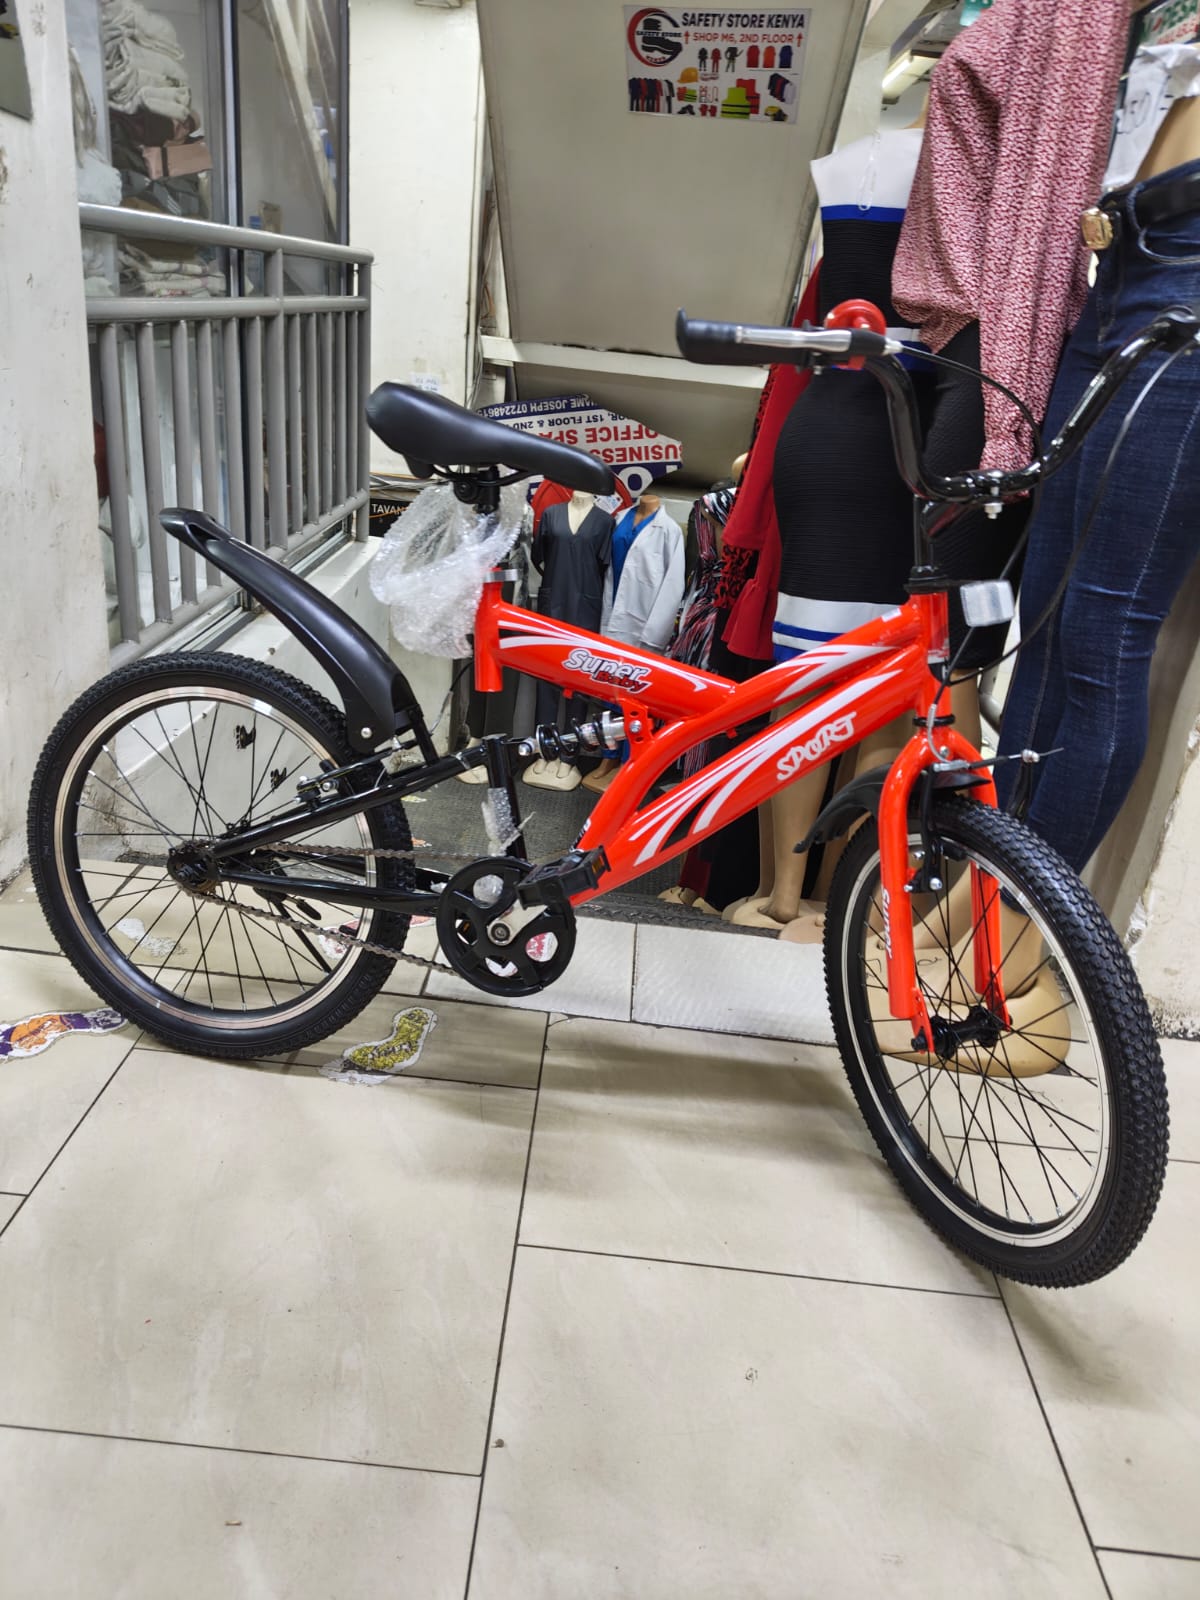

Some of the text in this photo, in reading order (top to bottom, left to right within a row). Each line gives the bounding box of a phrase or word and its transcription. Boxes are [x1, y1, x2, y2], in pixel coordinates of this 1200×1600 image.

[682, 13, 805, 29] SAFETY STORE KENYA
[693, 32, 719, 41] SHOP
[740, 34, 759, 43] 2ND
[761, 34, 794, 43] FLOOR
[530, 399, 567, 413] JOSEPH
[537, 419, 546, 428] &
[547, 415, 583, 427] FLOOR
[586, 414, 605, 424] 1ST
[590, 443, 683, 464] USINES
[563, 648, 651, 681] Super
[777, 711, 857, 780] SPORT
